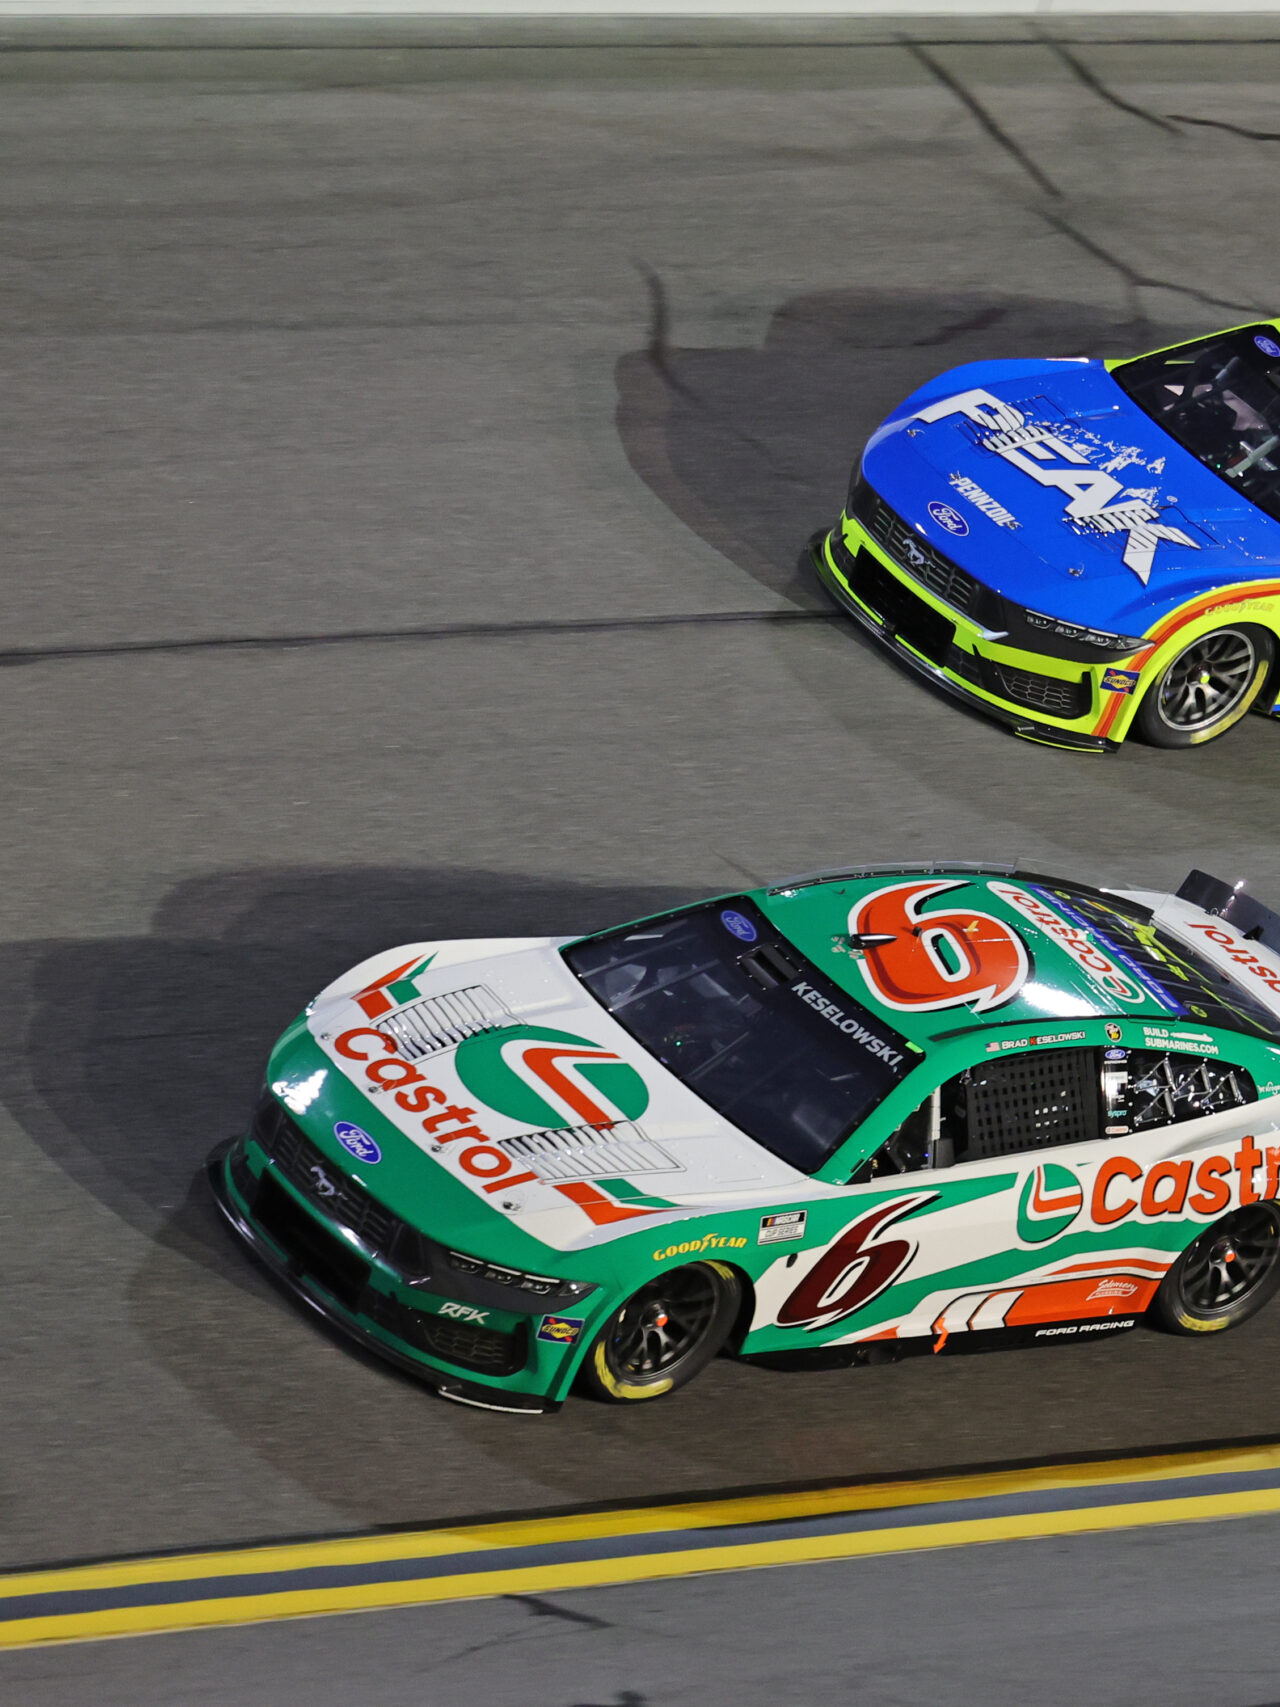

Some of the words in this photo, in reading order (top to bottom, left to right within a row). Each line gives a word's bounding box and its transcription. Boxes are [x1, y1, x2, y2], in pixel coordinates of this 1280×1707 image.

[912, 388, 1201, 586] PEAK
[950, 476, 1014, 528] PENNZOIL
[931, 504, 966, 533] Ford
[998, 889, 1113, 972] Castrol
[1035, 888, 1119, 951] RACING
[848, 879, 1032, 1013] 6
[1118, 953, 1180, 1009] FORD
[791, 981, 904, 1066] KESELOWSKI
[1143, 1026, 1169, 1038] BUILD
[1001, 1038, 1028, 1050] BRAD
[1029, 1030, 1086, 1046] KESELOWSKI
[1145, 1037, 1219, 1055] SUBMARINES.COM
[334, 1026, 545, 1195] Castrol
[338, 1127, 376, 1158] Ford
[653, 1233, 747, 1261] GOODYEAR
[765, 1228, 778, 1238] CUP
[778, 1192, 942, 1331] 6
[438, 1302, 490, 1325] RFK
[1035, 1327, 1078, 1337] FORD
[1079, 1320, 1135, 1332] RACING
[541, 1323, 580, 1337] SUNOCO
